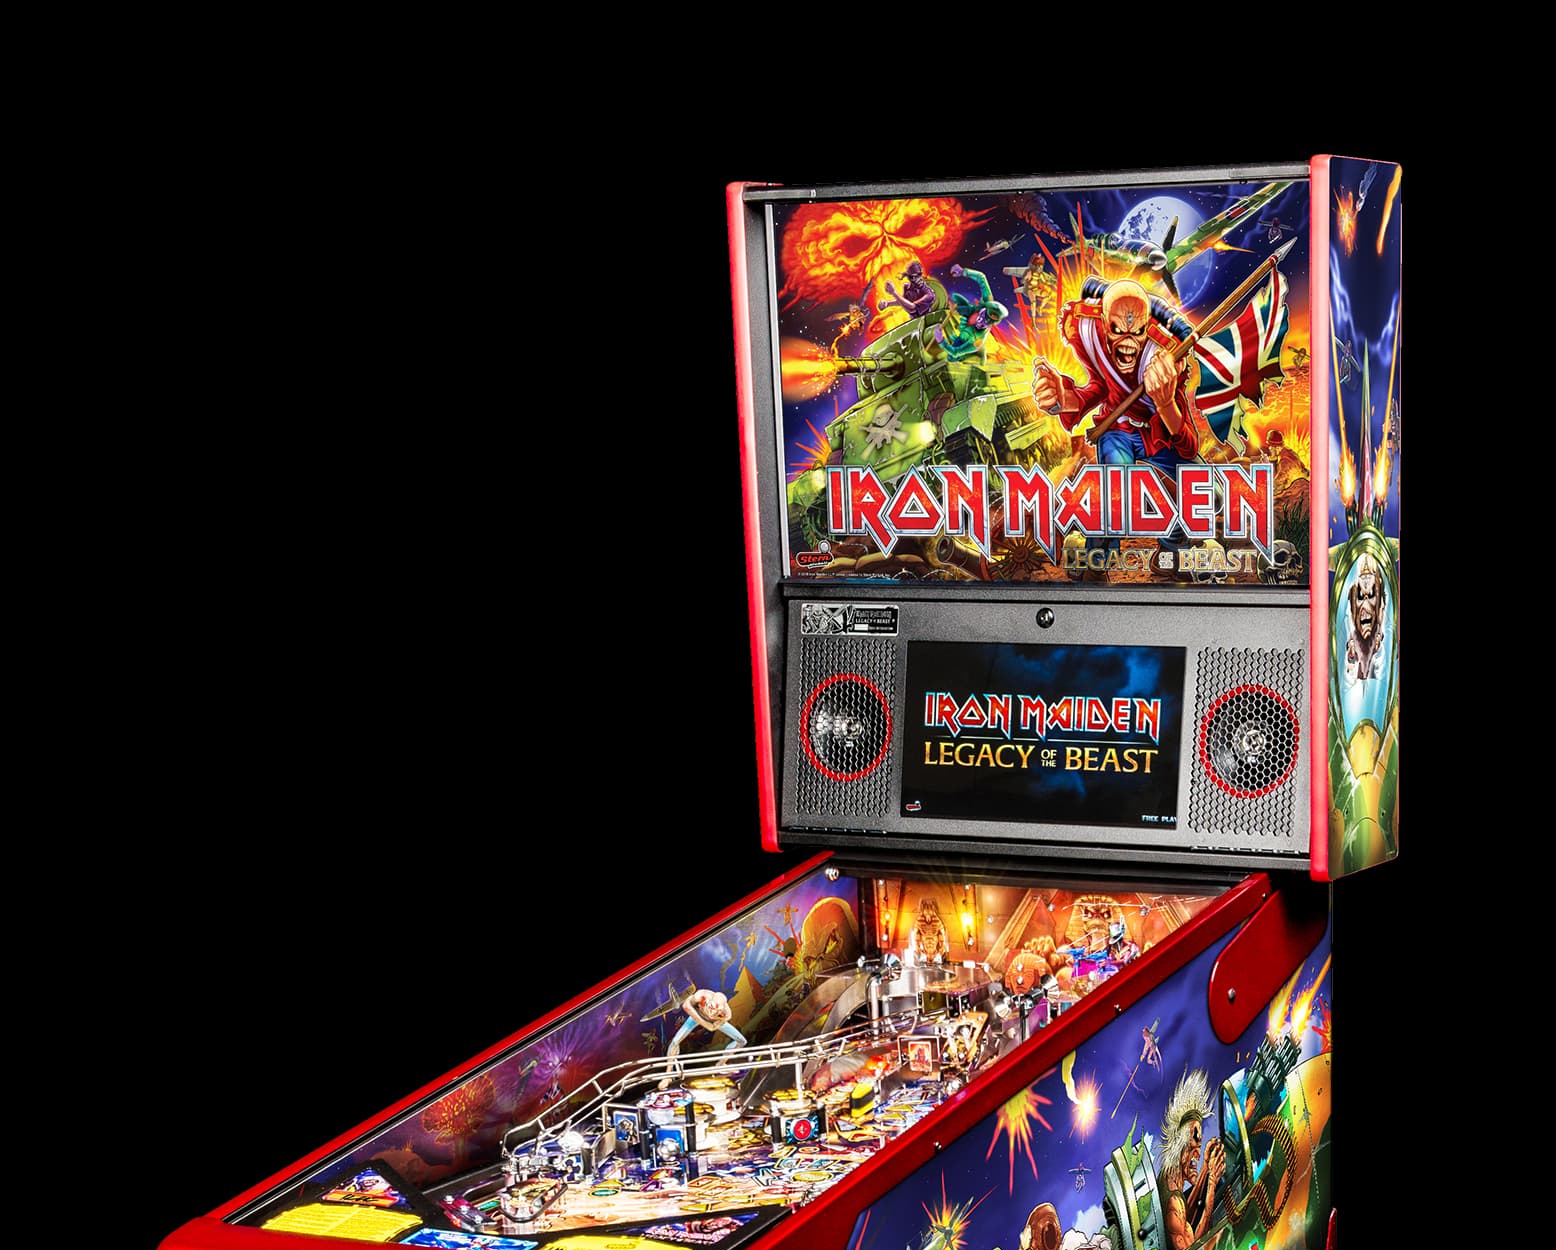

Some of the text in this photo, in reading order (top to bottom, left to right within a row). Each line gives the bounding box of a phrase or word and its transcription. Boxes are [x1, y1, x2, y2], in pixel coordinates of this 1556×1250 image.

[826, 462, 1275, 568] IRON MAIDEN
[799, 554, 830, 564] Stern
[1061, 548, 1158, 572] LEGACY
[1178, 548, 1259, 573] BEAST
[923, 691, 1162, 746] IRON MAIDEN
[924, 741, 1159, 773] LEGACY OF BEAST
[1040, 759, 1057, 768] THE
